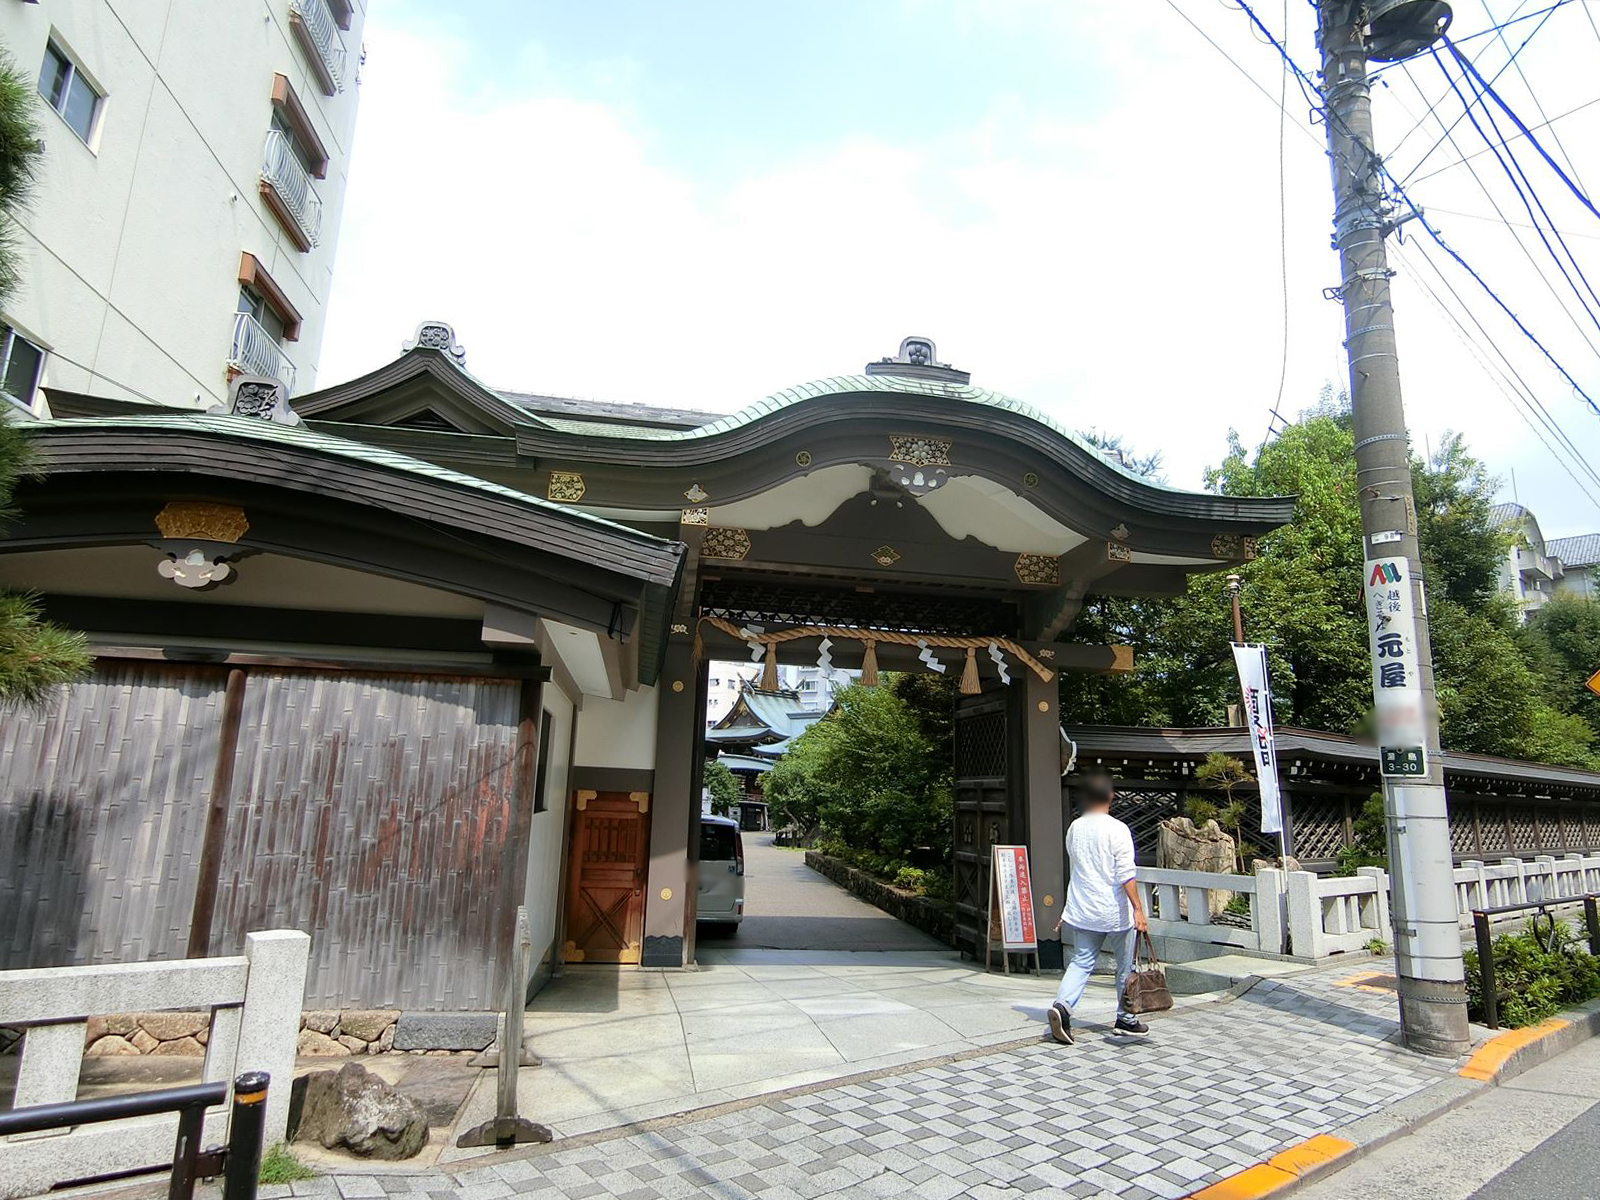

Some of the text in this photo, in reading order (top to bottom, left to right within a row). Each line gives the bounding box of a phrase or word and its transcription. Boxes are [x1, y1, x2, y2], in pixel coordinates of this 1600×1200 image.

[1387, 589, 1401, 612] 越後
[1377, 632, 1407, 688] 元屋
[1388, 762, 1417, 772] 3-30
